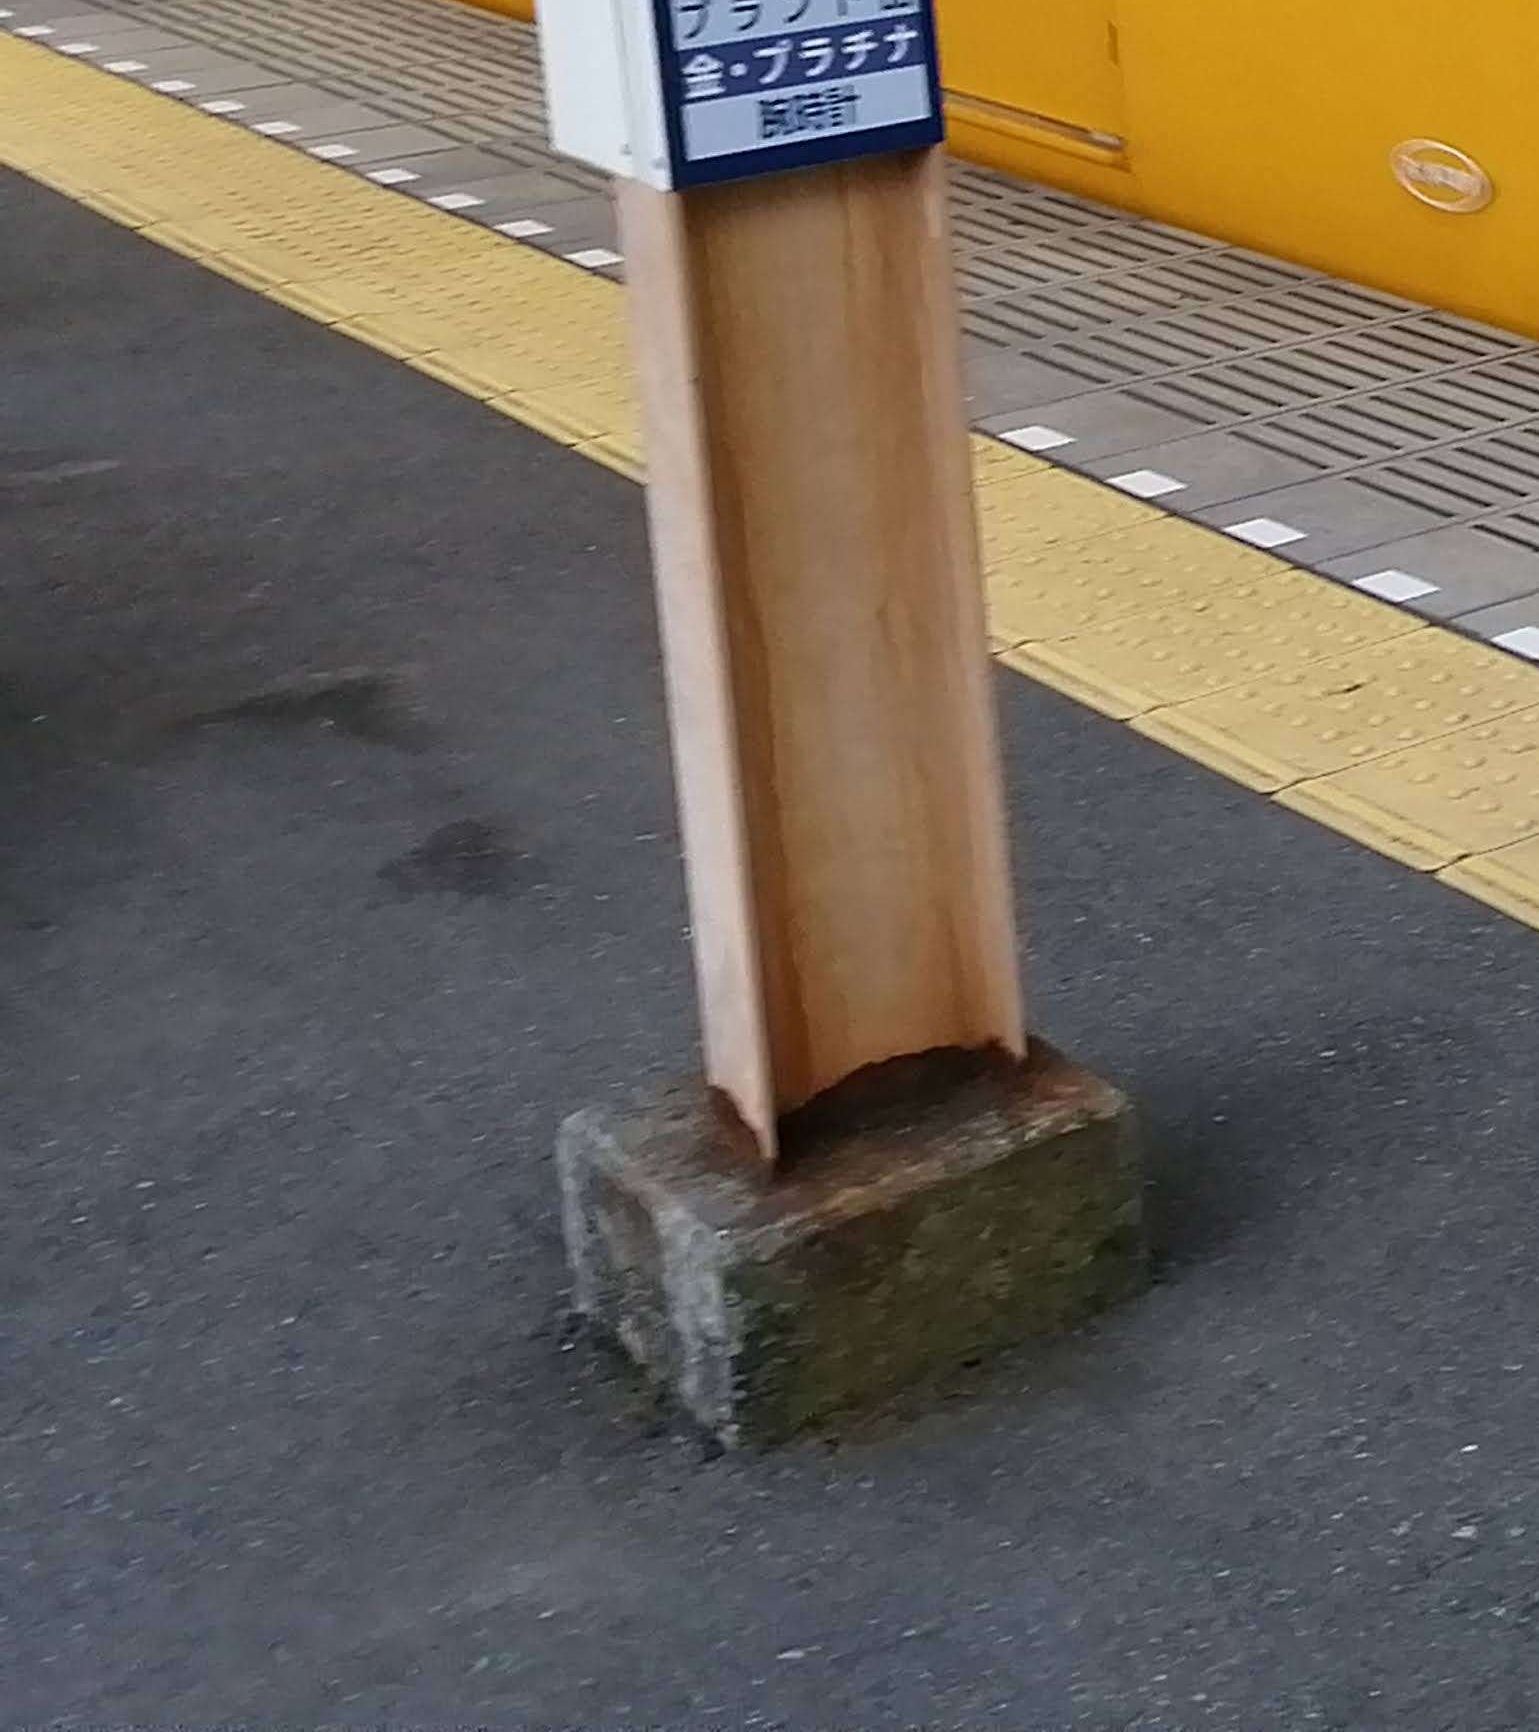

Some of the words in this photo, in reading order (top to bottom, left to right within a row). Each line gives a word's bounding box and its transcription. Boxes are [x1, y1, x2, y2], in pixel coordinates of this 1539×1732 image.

[681, 23, 919, 100] 金・プラチナ
